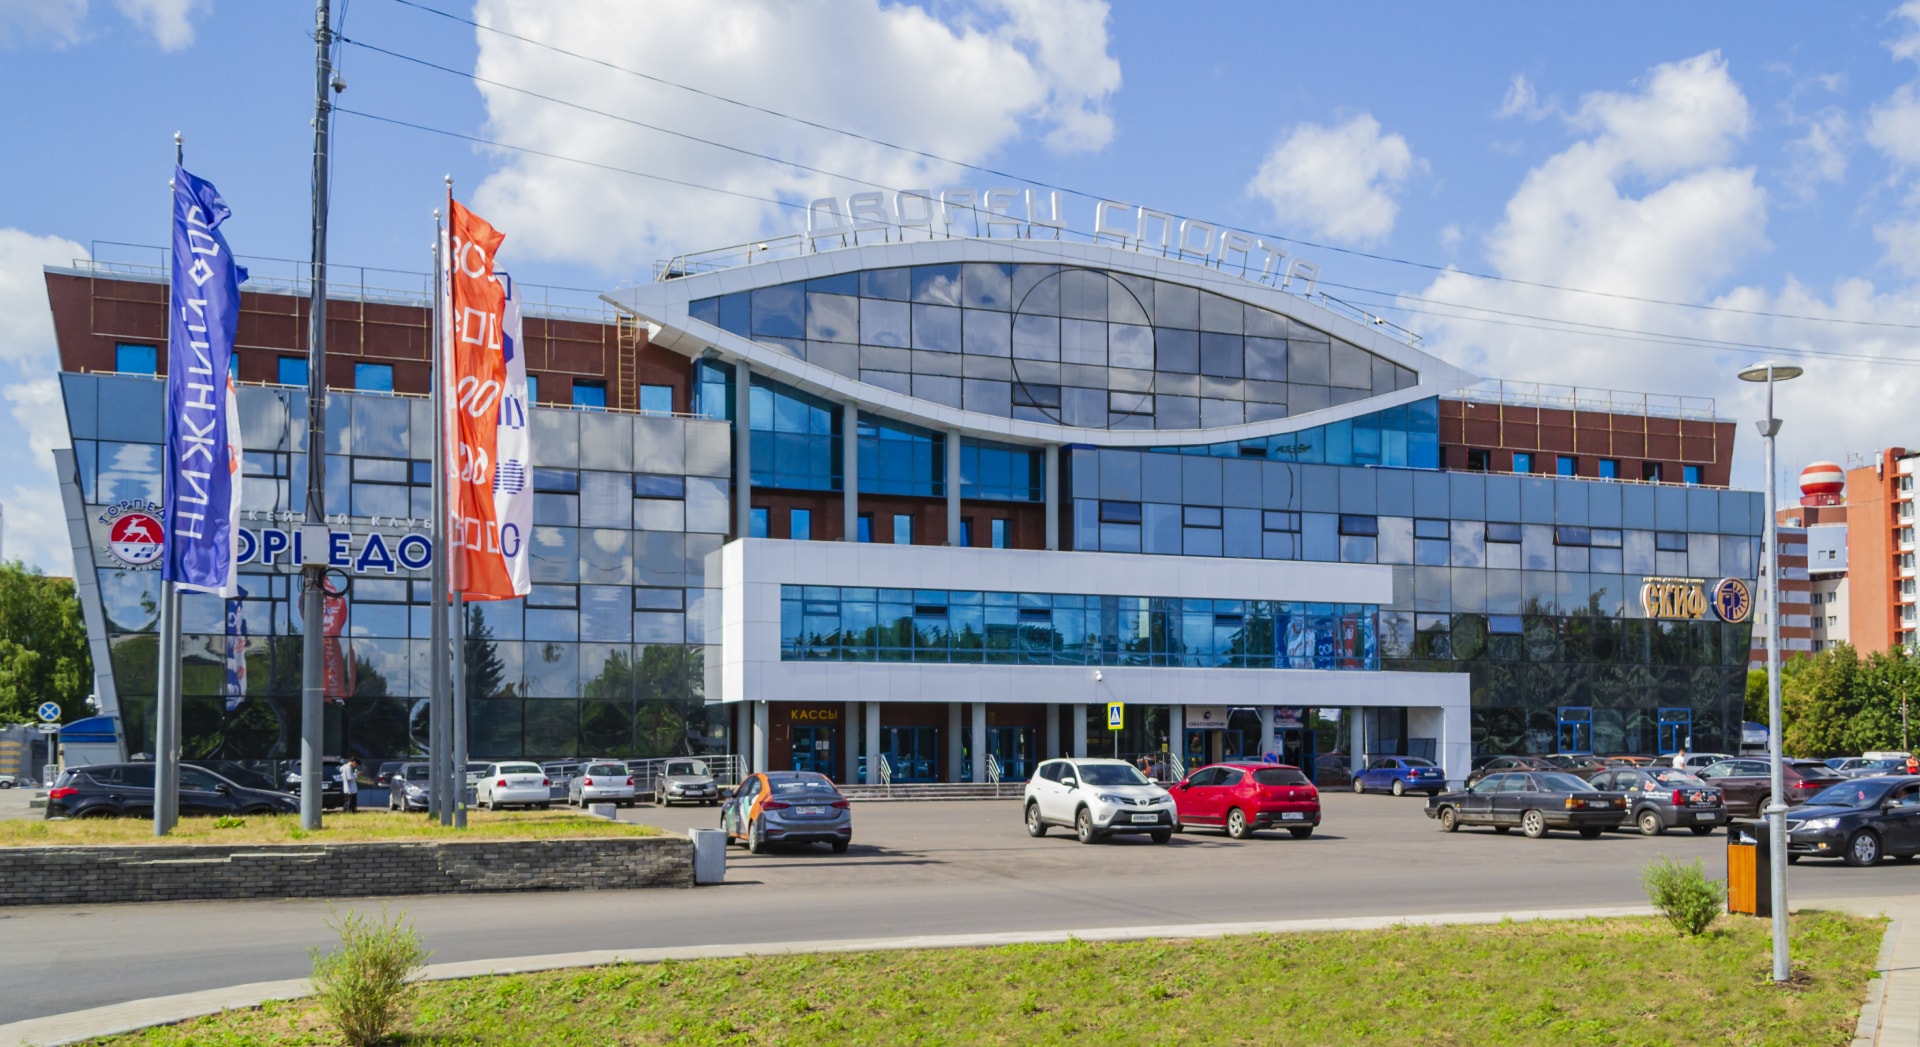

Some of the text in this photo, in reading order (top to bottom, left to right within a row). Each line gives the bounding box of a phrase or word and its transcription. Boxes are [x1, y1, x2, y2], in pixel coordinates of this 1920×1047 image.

[806, 188, 1322, 297] ДВОРЕЦ СПОРТА
[174, 298, 216, 539] НИЖНИЙ
[98, 499, 166, 526] ТОРПЕД
[371, 515, 432, 529] КЛУБ
[1641, 583, 1708, 619] СКИФ
[791, 709, 838, 720] КАССЫ
